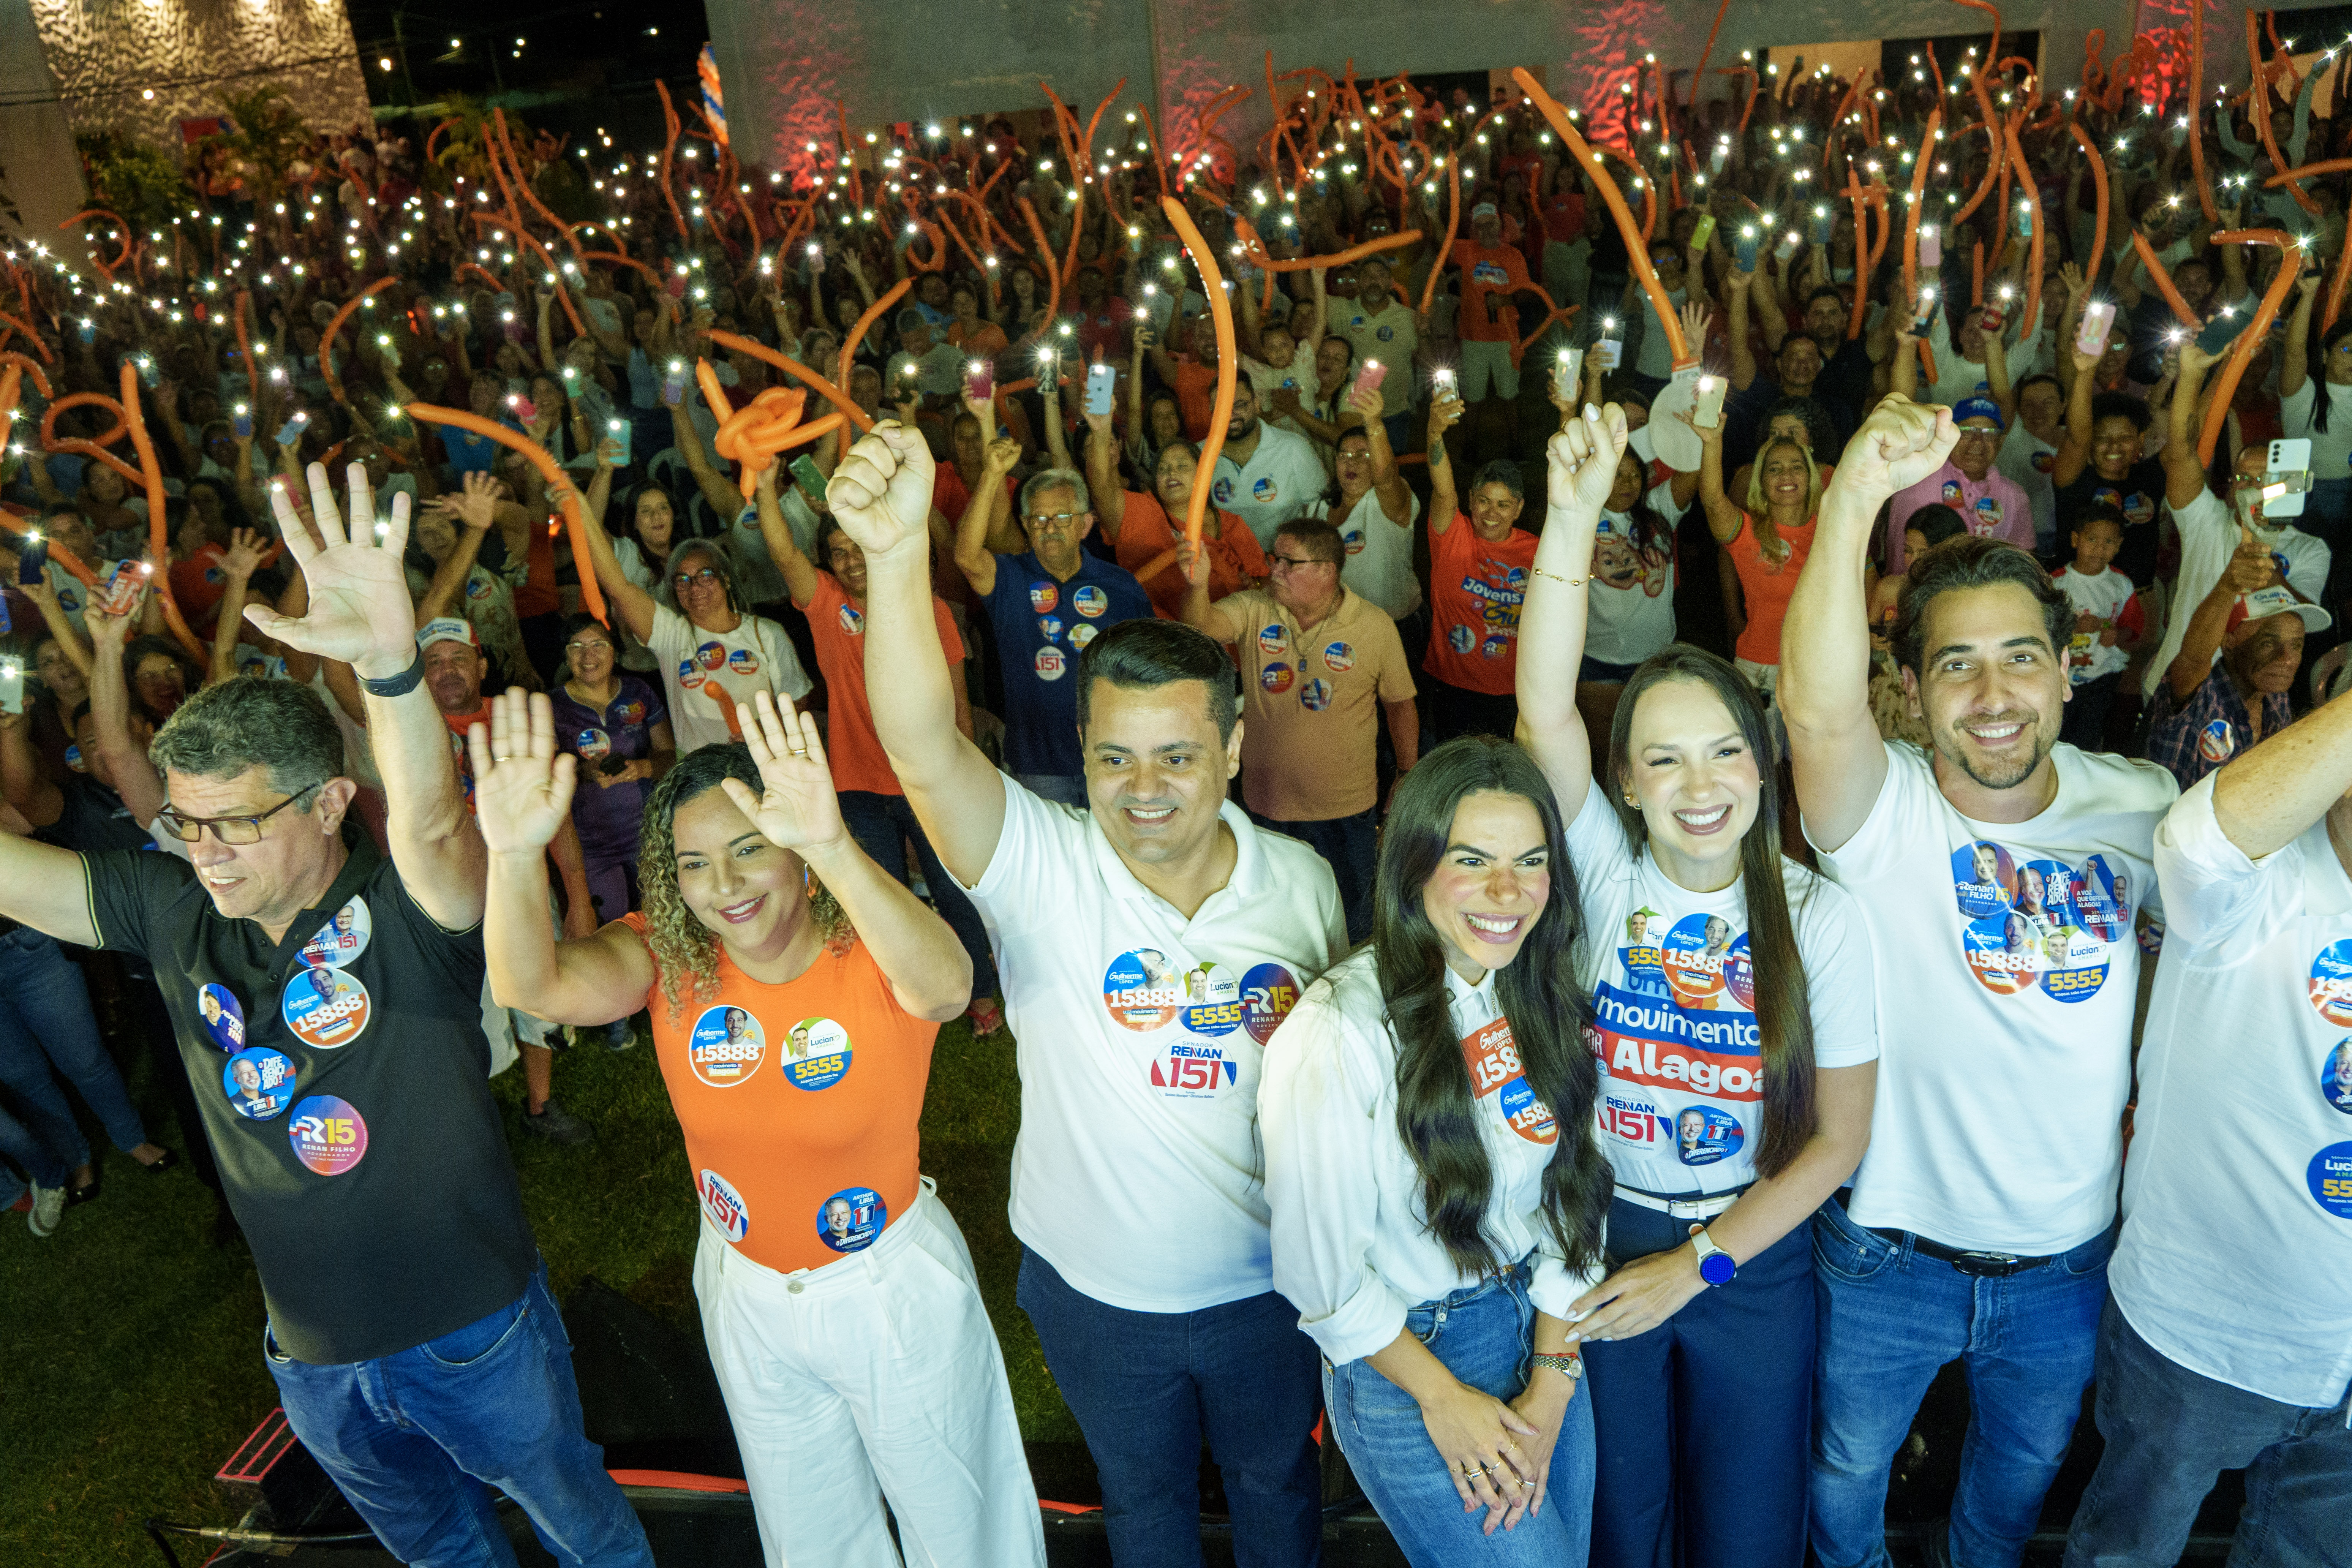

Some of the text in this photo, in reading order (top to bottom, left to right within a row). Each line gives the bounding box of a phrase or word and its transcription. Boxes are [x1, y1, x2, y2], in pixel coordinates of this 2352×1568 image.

[1464, 578, 1521, 603] Jovens
[1958, 881, 1994, 893] Renan
[1969, 891, 1993, 900] FILHO
[1995, 887, 2010, 902] 15
[1671, 931, 1704, 944] Guilherme
[1109, 972, 1143, 980] Guilherme
[1680, 975, 1710, 987] Alagoas
[2049, 968, 2103, 991] 5555
[1110, 988, 1176, 1007] 15888
[296, 994, 364, 1033] 15888
[1190, 1004, 1242, 1026] 5555
[1171, 1045, 1222, 1059] RENAN
[1494, 1037, 1512, 1050] LOPES
[696, 1044, 759, 1062] 15888
[262, 1056, 282, 1069] DIFE
[795, 1054, 844, 1079] 5555
[1170, 1057, 1220, 1089] 151
[1504, 1090, 1532, 1105] Guilherme
[1606, 1096, 1654, 1114] RENAN
[1607, 1106, 1654, 1142] 151
[1707, 1124, 1732, 1141] 111
[710, 1175, 741, 1212] RENAN
[852, 1192, 874, 1201] ARTHUR
[859, 1196, 874, 1204] LIRA
[708, 1182, 738, 1232] 151
[854, 1204, 875, 1225] 111
